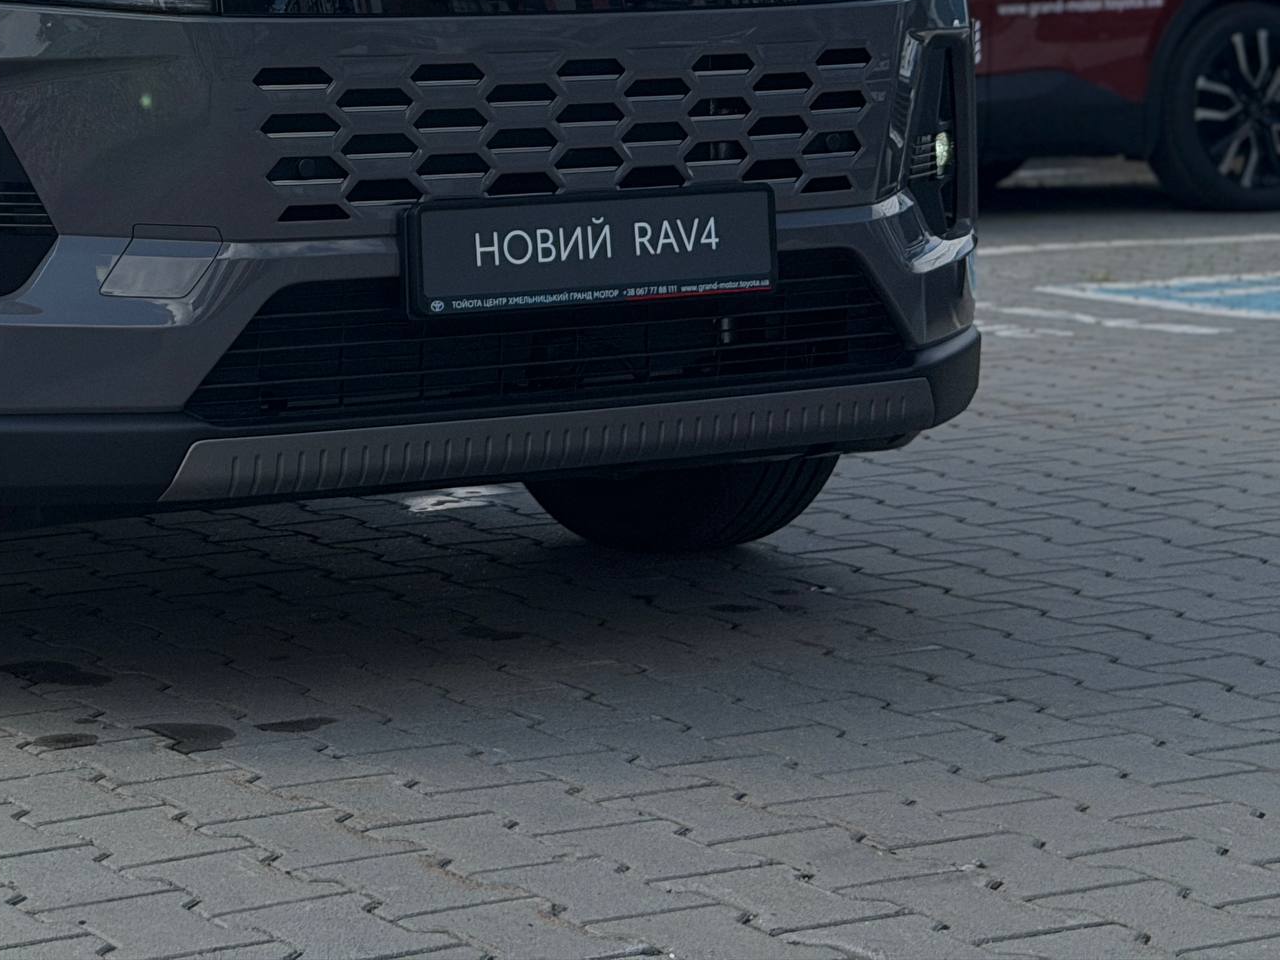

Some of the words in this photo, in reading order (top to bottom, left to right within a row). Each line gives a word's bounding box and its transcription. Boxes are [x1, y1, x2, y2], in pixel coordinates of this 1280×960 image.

[474, 216, 613, 267] НОВИЙ
[633, 216, 720, 257] RAV4
[452, 298, 482, 309] ТОЙОТА
[484, 297, 507, 307] ЦЕНТР
[508, 292, 568, 304] ХМЕЛЬНИЦЬКИЙ
[570, 291, 593, 300] ГРАНД
[593, 289, 619, 298] МОТОР
